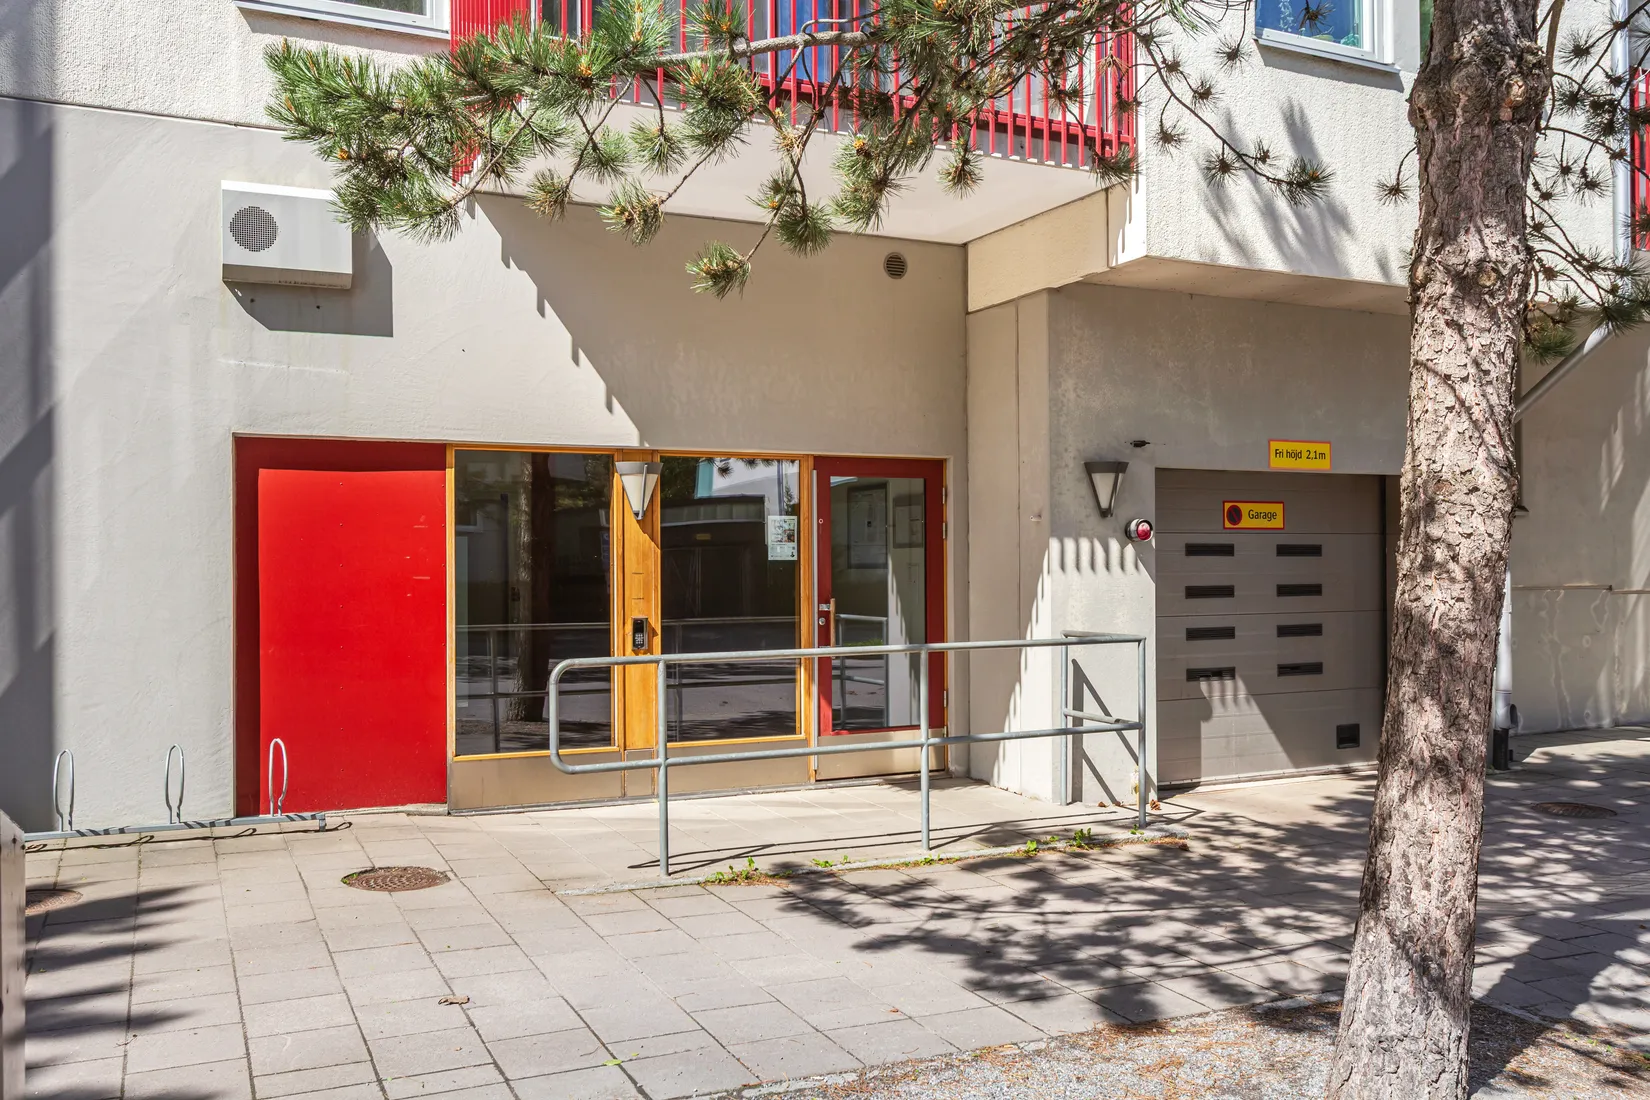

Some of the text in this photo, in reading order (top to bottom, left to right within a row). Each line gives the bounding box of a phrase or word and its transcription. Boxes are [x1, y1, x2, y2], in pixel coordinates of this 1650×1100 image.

[1274, 448, 1284, 458] Fri
[1286, 449, 1302, 460] höjd
[1248, 509, 1278, 522] Garage
